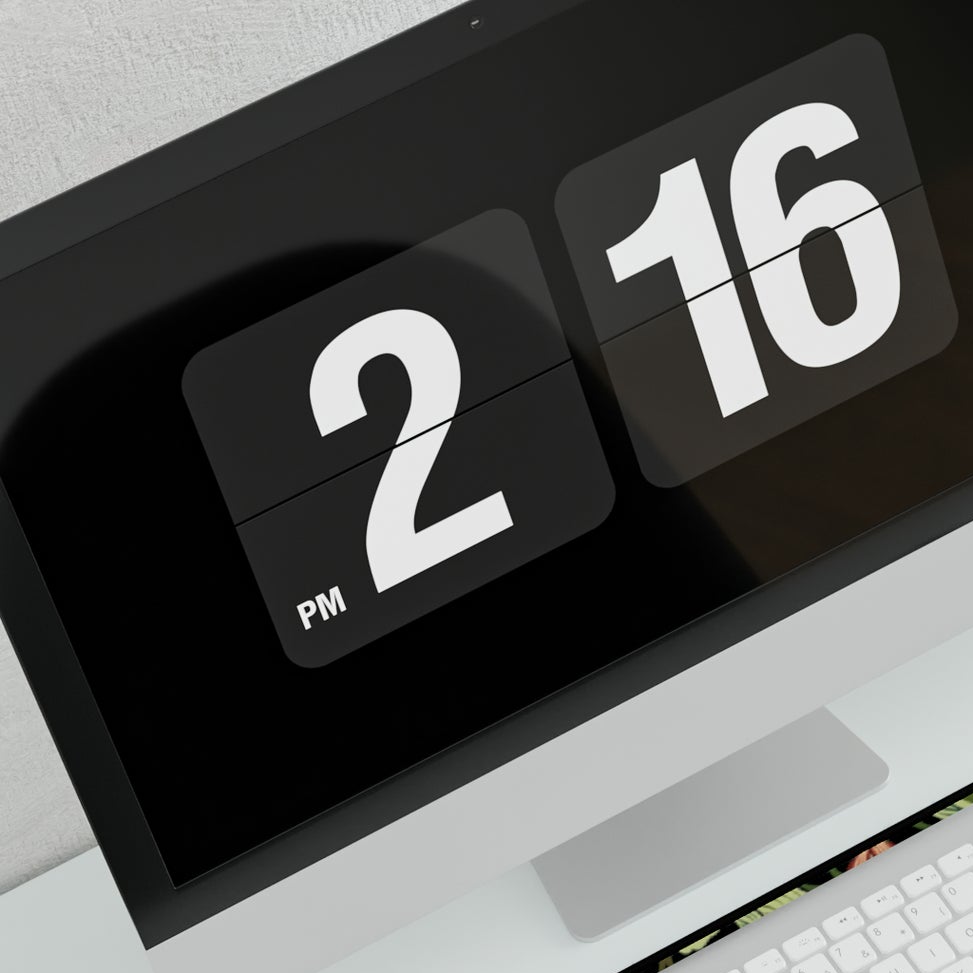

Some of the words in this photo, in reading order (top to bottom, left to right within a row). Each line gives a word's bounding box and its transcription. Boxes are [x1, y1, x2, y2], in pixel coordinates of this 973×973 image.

[309, 308, 514, 594] 2
[605, 102, 901, 419] 16
[296, 585, 347, 631] PM
[834, 946, 843, 958] 7
[871, 927, 883, 937] 8
[909, 906, 920, 918] 9
[947, 886, 958, 896] 0
